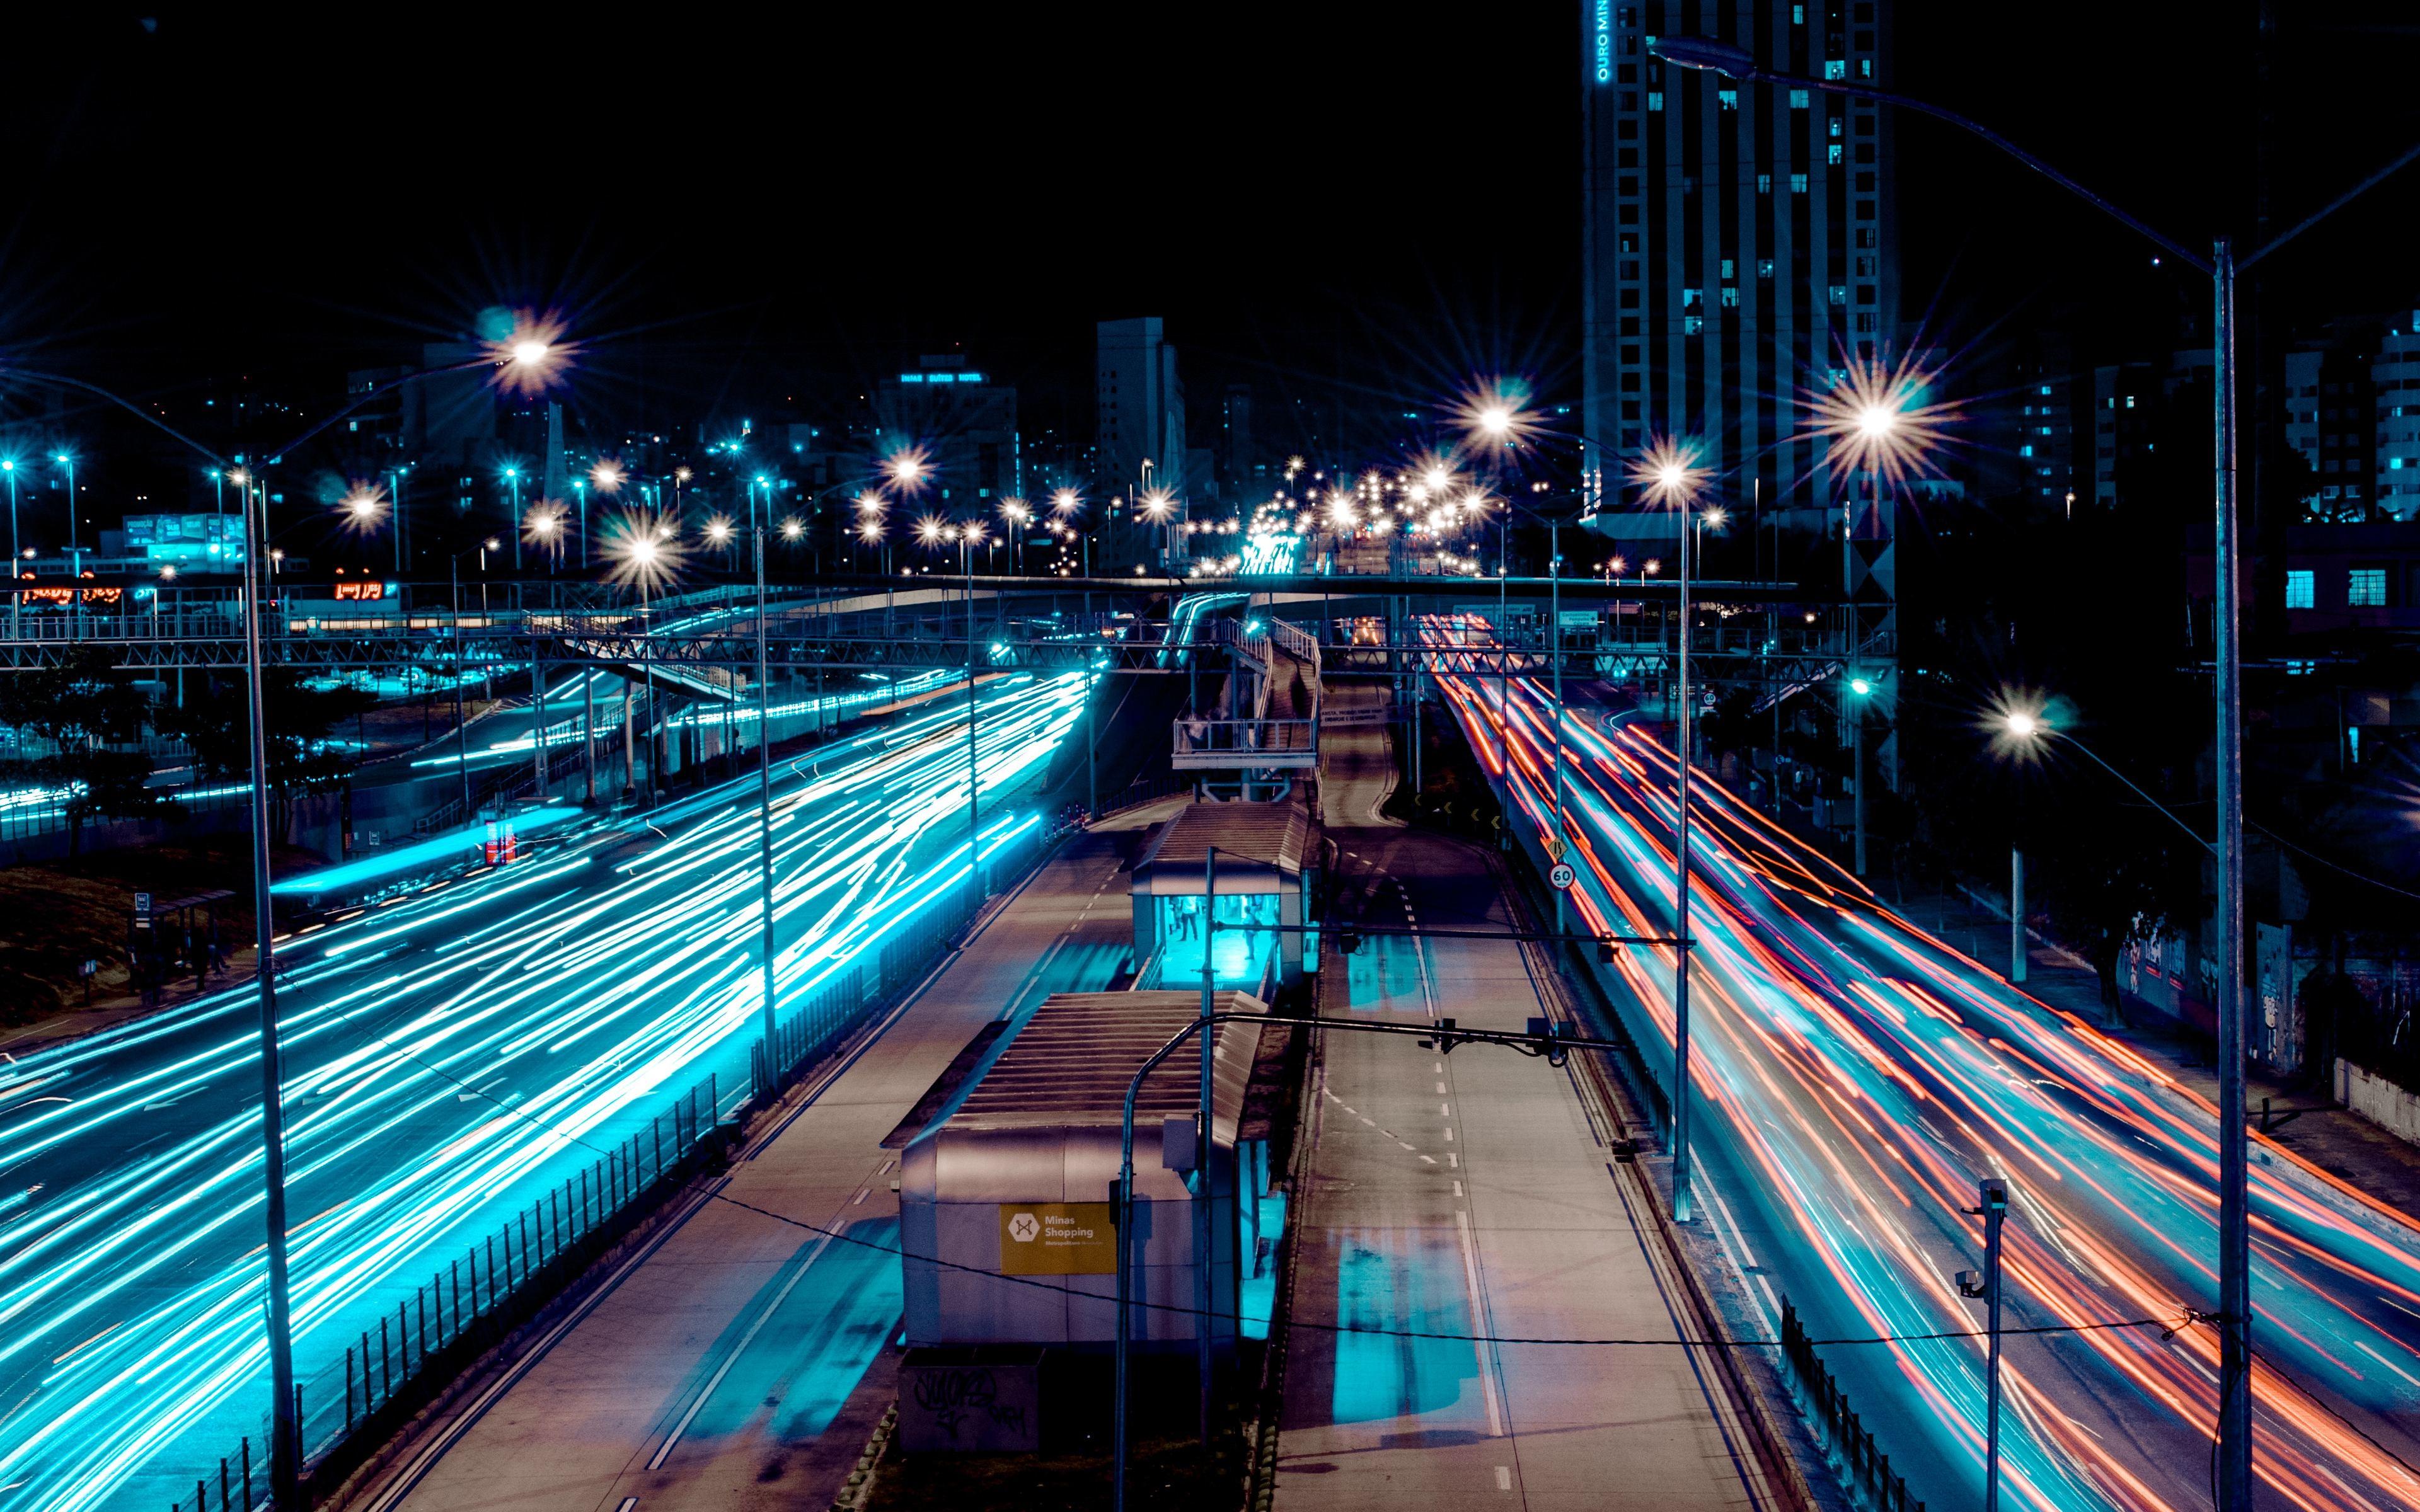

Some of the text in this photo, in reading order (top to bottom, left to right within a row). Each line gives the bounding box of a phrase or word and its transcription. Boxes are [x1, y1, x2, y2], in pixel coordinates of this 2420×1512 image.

[1598, 34, 1608, 80] OURO
[1553, 871, 1570, 881] 60
[1045, 1216, 1075, 1224] Minas
[1045, 1227, 1093, 1238] Shopping
